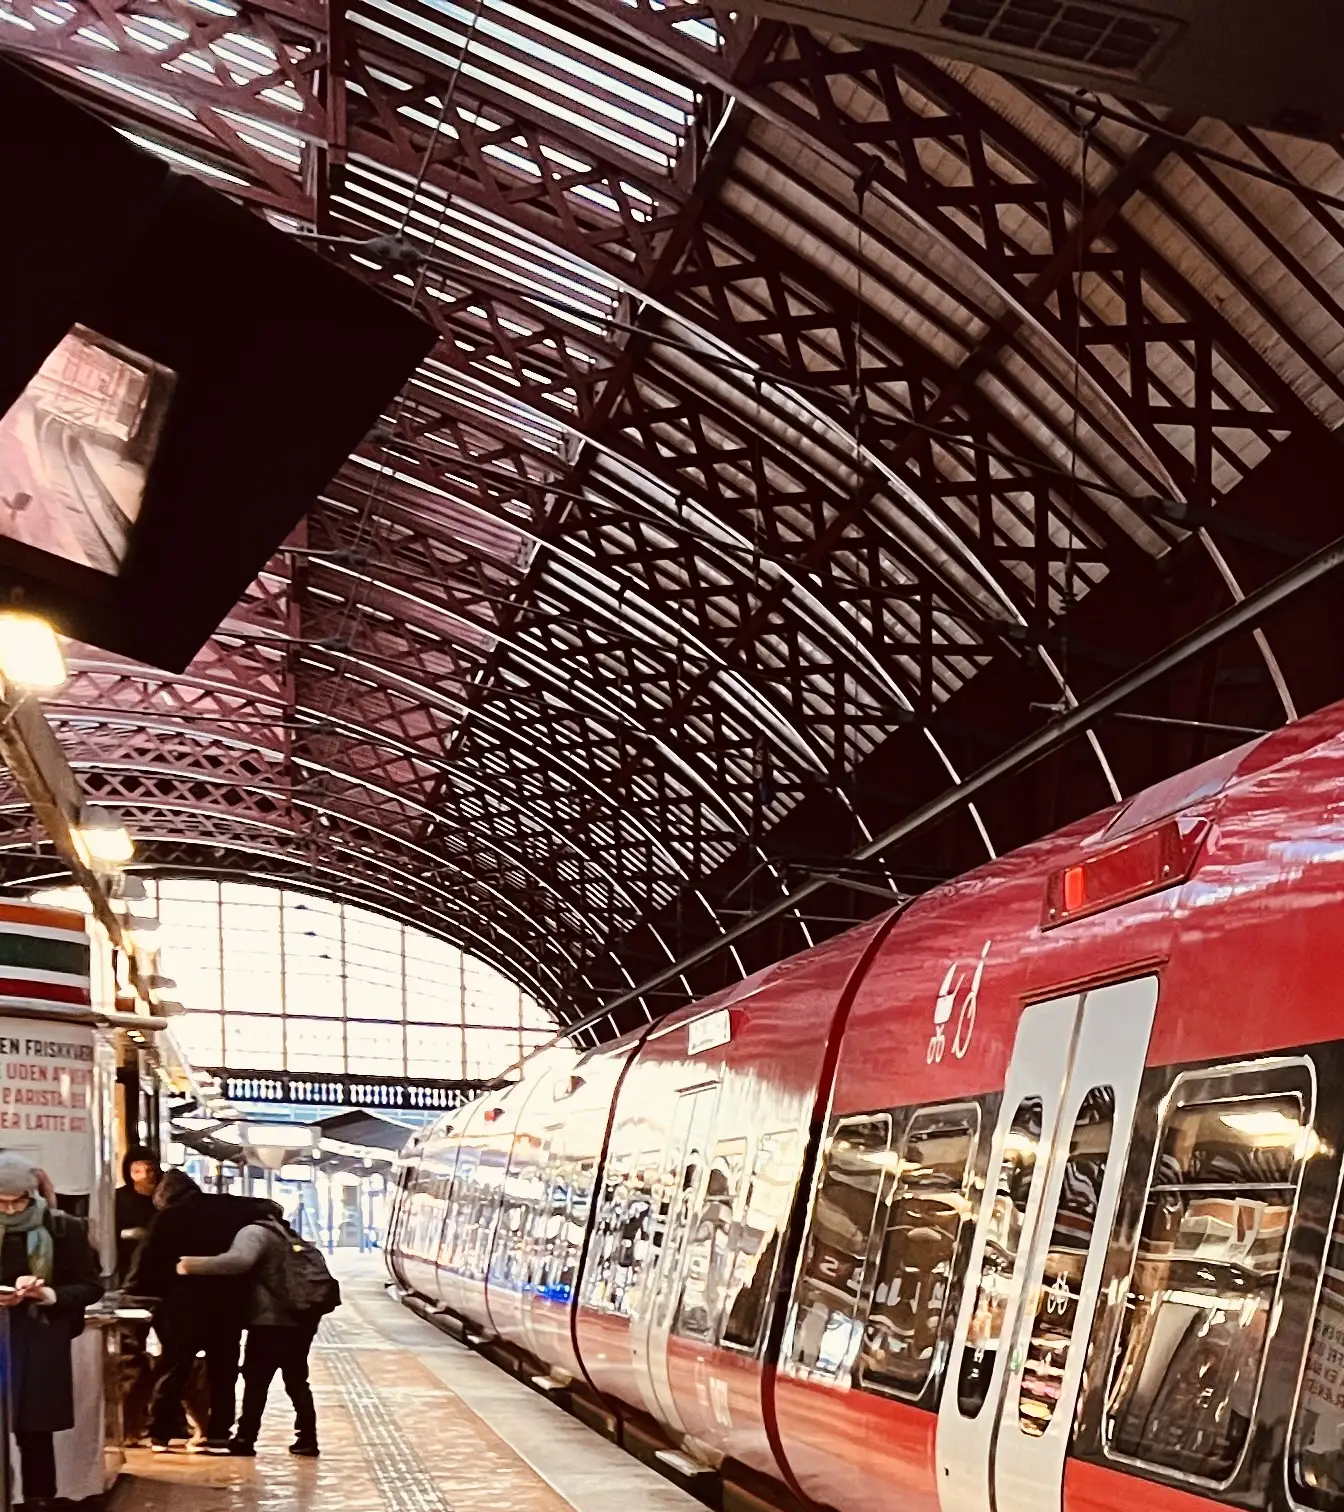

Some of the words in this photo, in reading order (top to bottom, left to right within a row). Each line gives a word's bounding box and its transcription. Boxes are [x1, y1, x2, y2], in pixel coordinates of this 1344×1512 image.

[6, 1063, 48, 1081] UDEN
[0, 1111, 20, 1130] ER
[25, 1113, 67, 1132] LATTE
